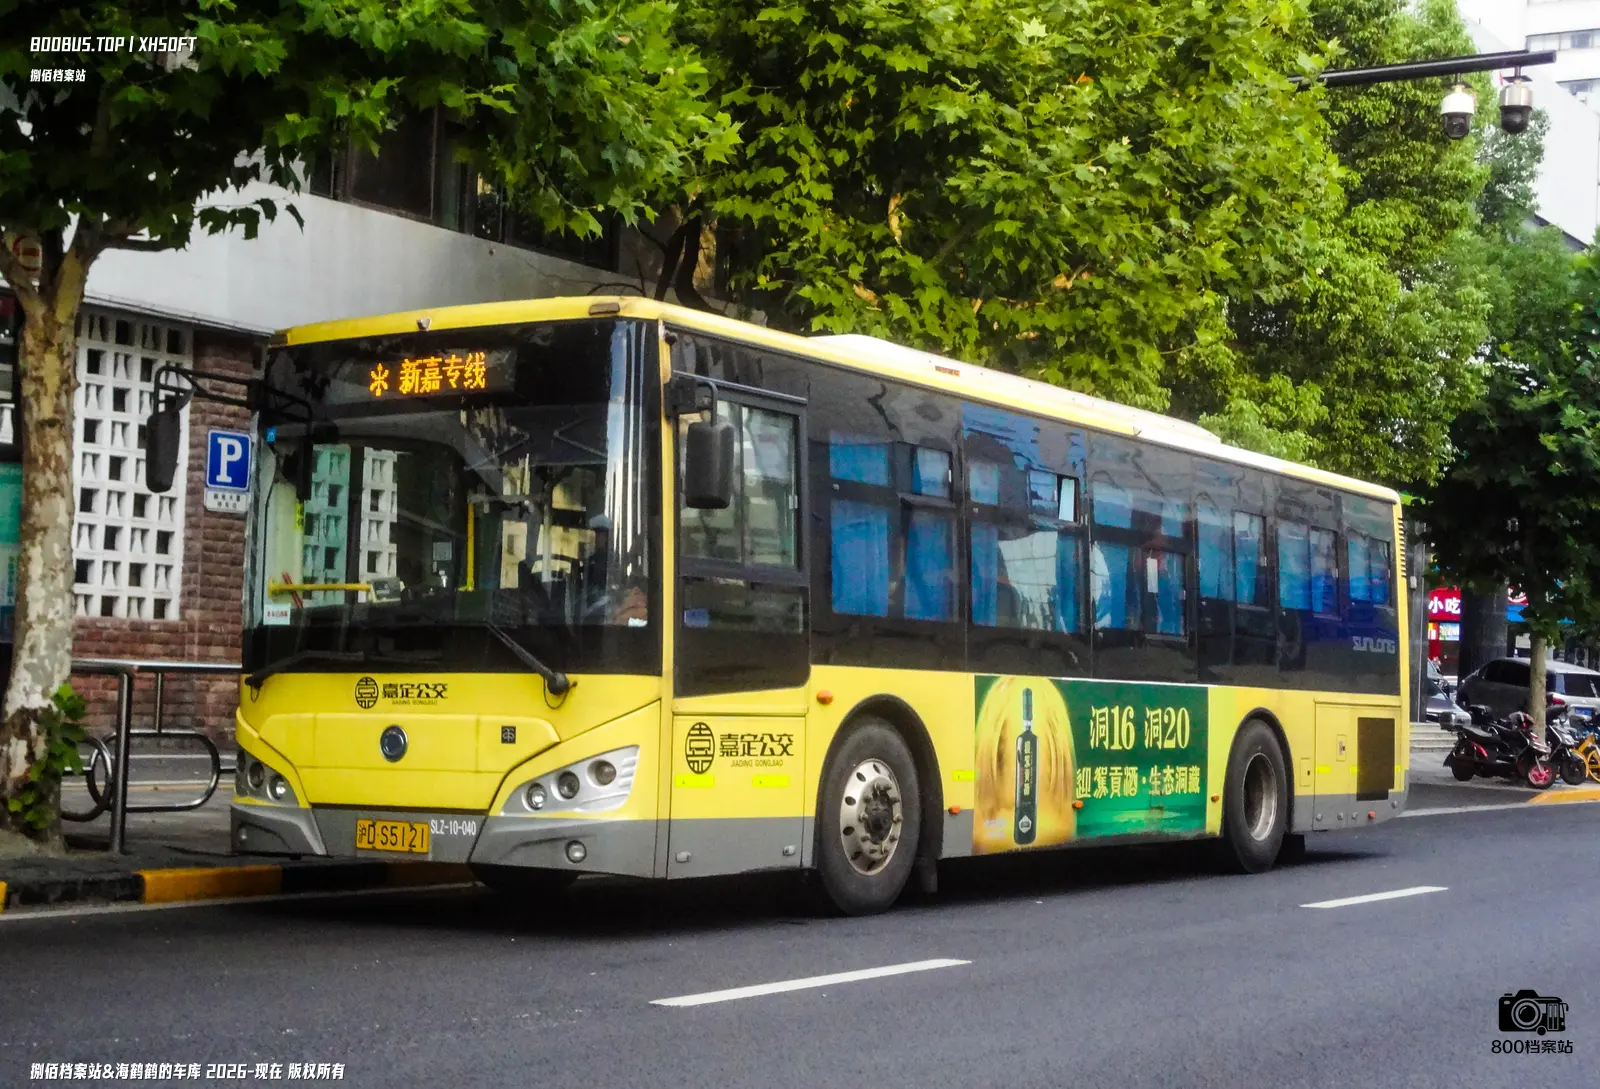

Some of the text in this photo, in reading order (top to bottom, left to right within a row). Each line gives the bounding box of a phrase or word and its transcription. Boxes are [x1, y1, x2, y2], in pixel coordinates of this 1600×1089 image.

[399, 352, 487, 394] 新嘉专线
[216, 437, 242, 483] P
[1428, 596, 1461, 615] 小吃
[382, 683, 448, 699] 嘉定公交
[1090, 705, 1190, 750] 洞16 洞20
[719, 733, 794, 757] 嘉定公交
[731, 760, 753, 768] JIADING
[430, 819, 477, 836] SLZ-10-040
